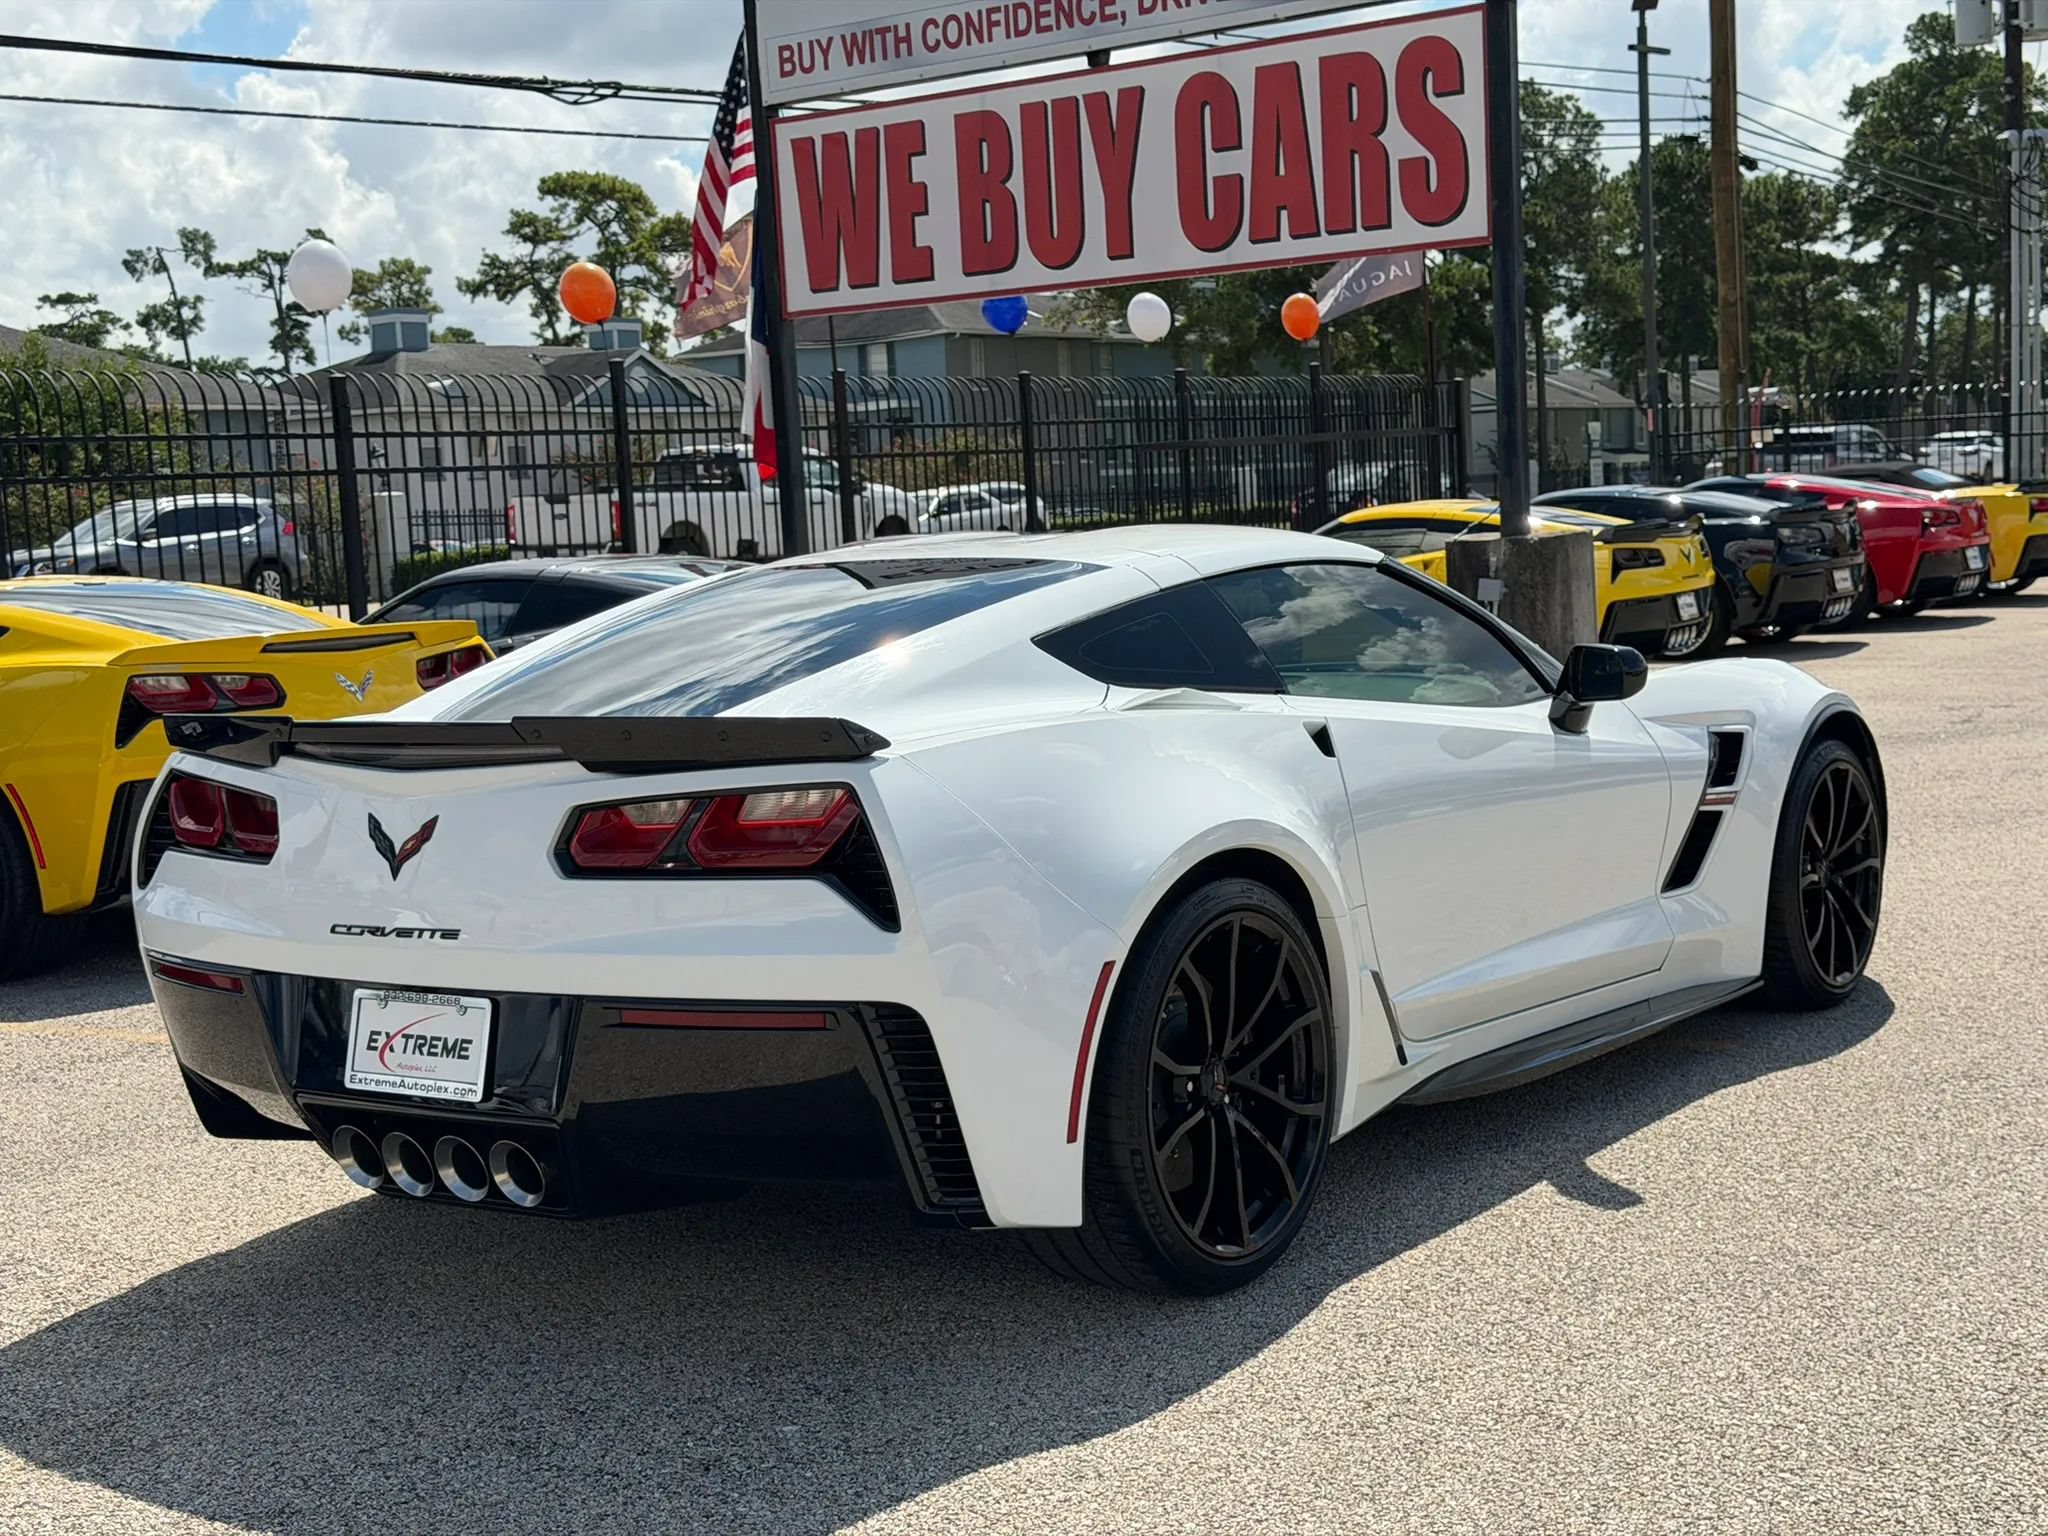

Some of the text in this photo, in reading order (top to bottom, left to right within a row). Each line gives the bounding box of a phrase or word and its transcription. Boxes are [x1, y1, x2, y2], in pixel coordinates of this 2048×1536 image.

[777, 0, 1127, 78] BUY WITH CONFIDENCE,
[790, 35, 1470, 294] WE BUY CARS
[330, 923, 461, 940] CORVETTE
[383, 990, 461, 1006] 832-698-2668
[366, 1030, 473, 1061] EXTREME
[349, 1073, 478, 1098] ExtremeAutoplex.com
